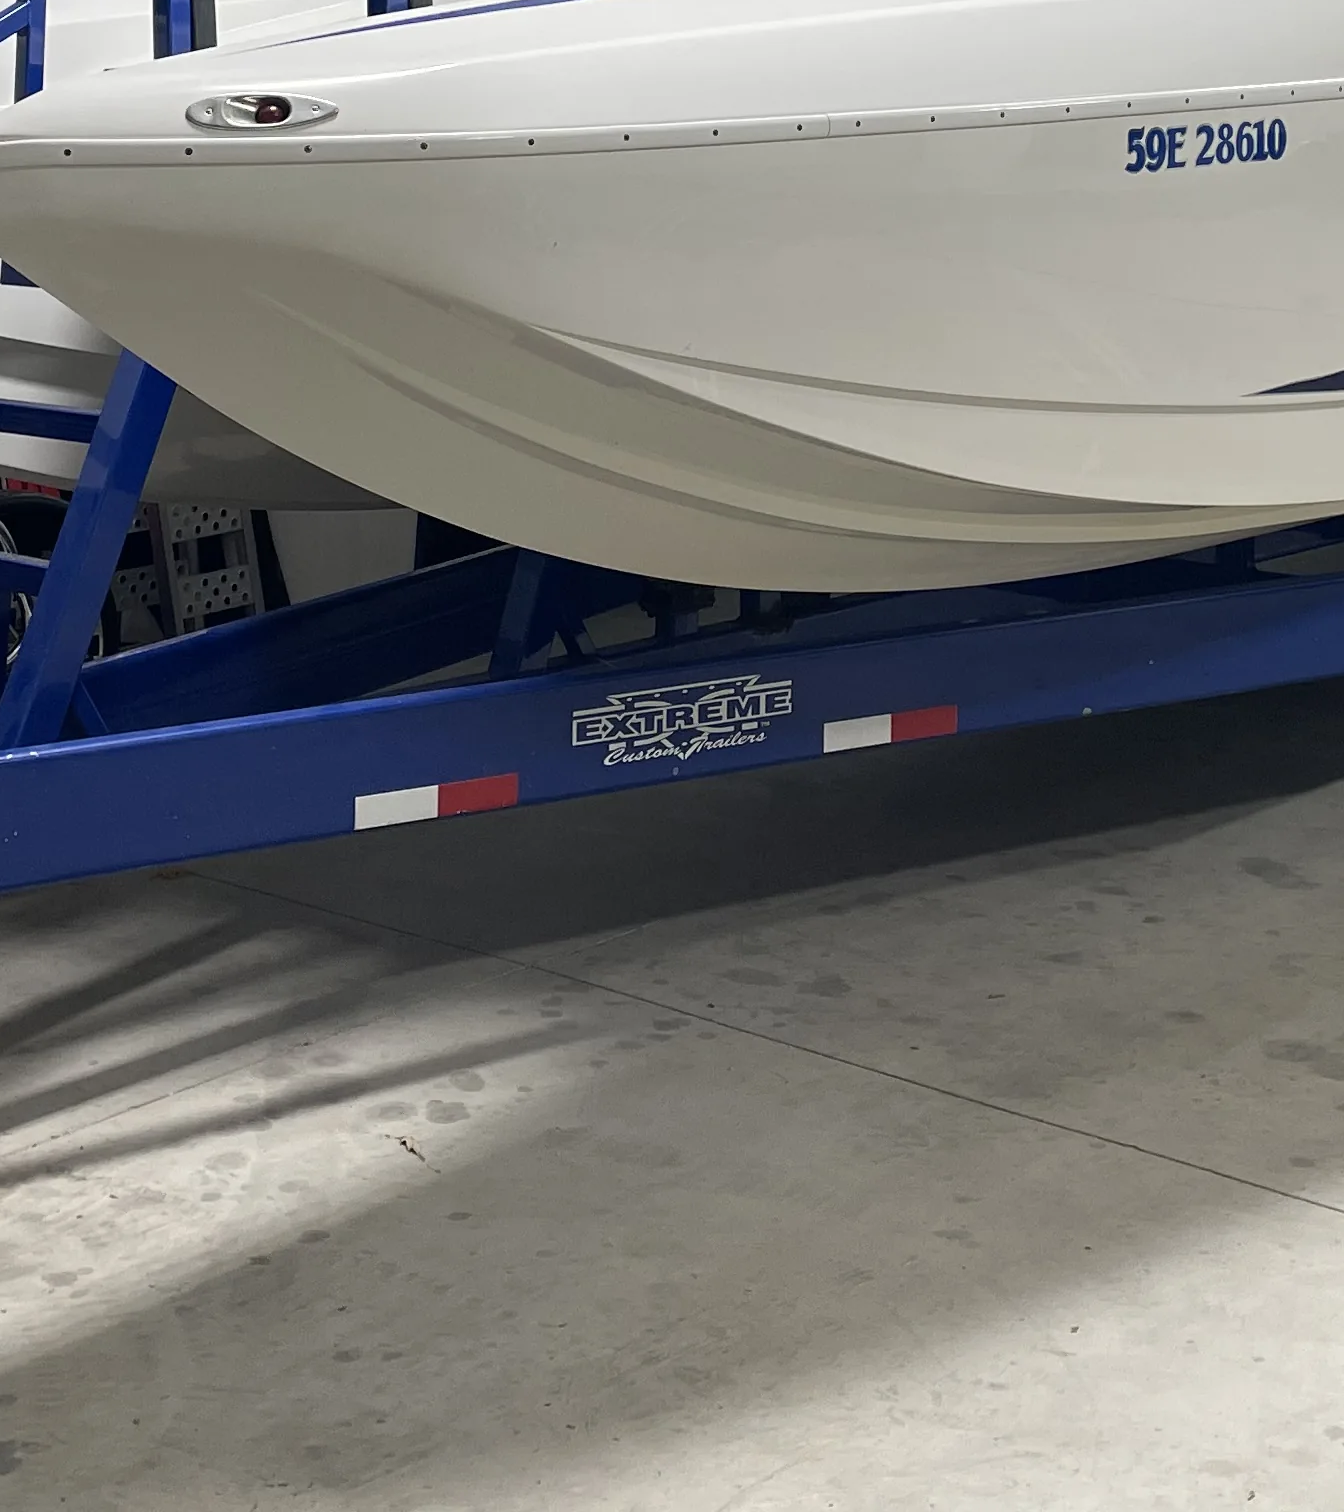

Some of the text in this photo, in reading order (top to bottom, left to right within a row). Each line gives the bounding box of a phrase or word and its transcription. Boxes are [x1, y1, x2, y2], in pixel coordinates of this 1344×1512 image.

[1125, 118, 1288, 174] 59E 28610
[572, 687, 793, 747] EXTREME
[604, 729, 768, 766] Custom Trailers
